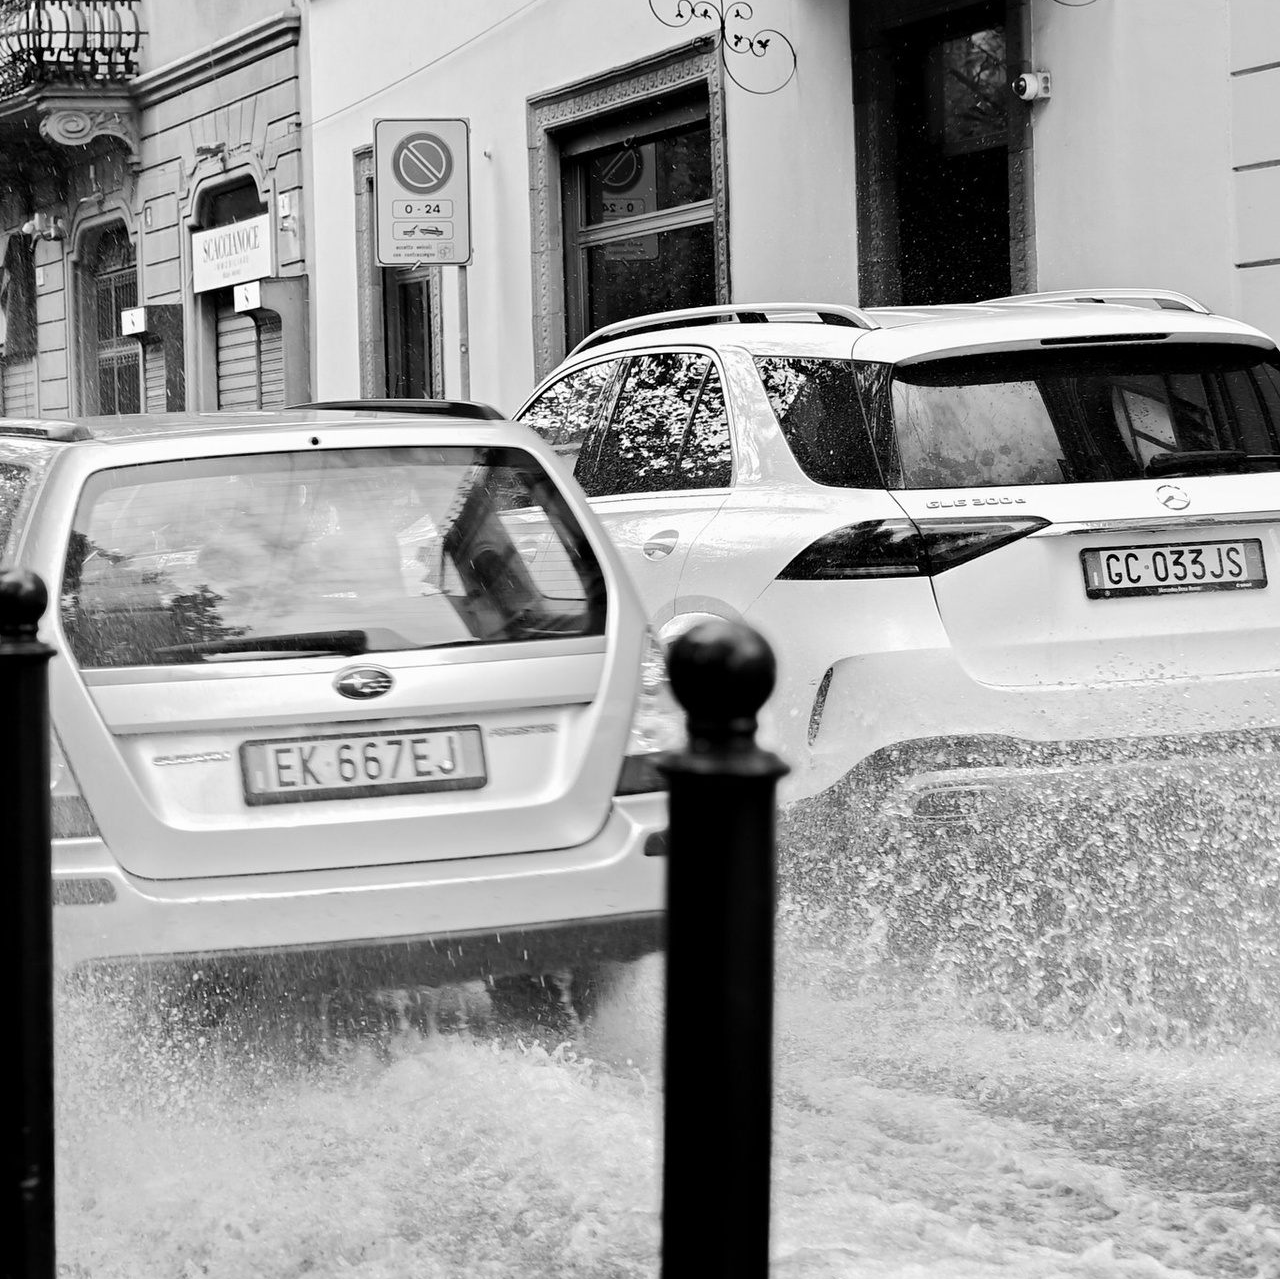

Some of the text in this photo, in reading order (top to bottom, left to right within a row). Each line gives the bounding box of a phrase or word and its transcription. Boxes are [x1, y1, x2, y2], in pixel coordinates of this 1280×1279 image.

[404, 204, 413, 214] 0
[424, 204, 441, 214] 24
[202, 225, 260, 263] SCACCIANOCE
[1105, 547, 1243, 585] GC 033JS
[275, 736, 456, 788] EK 667EJ
